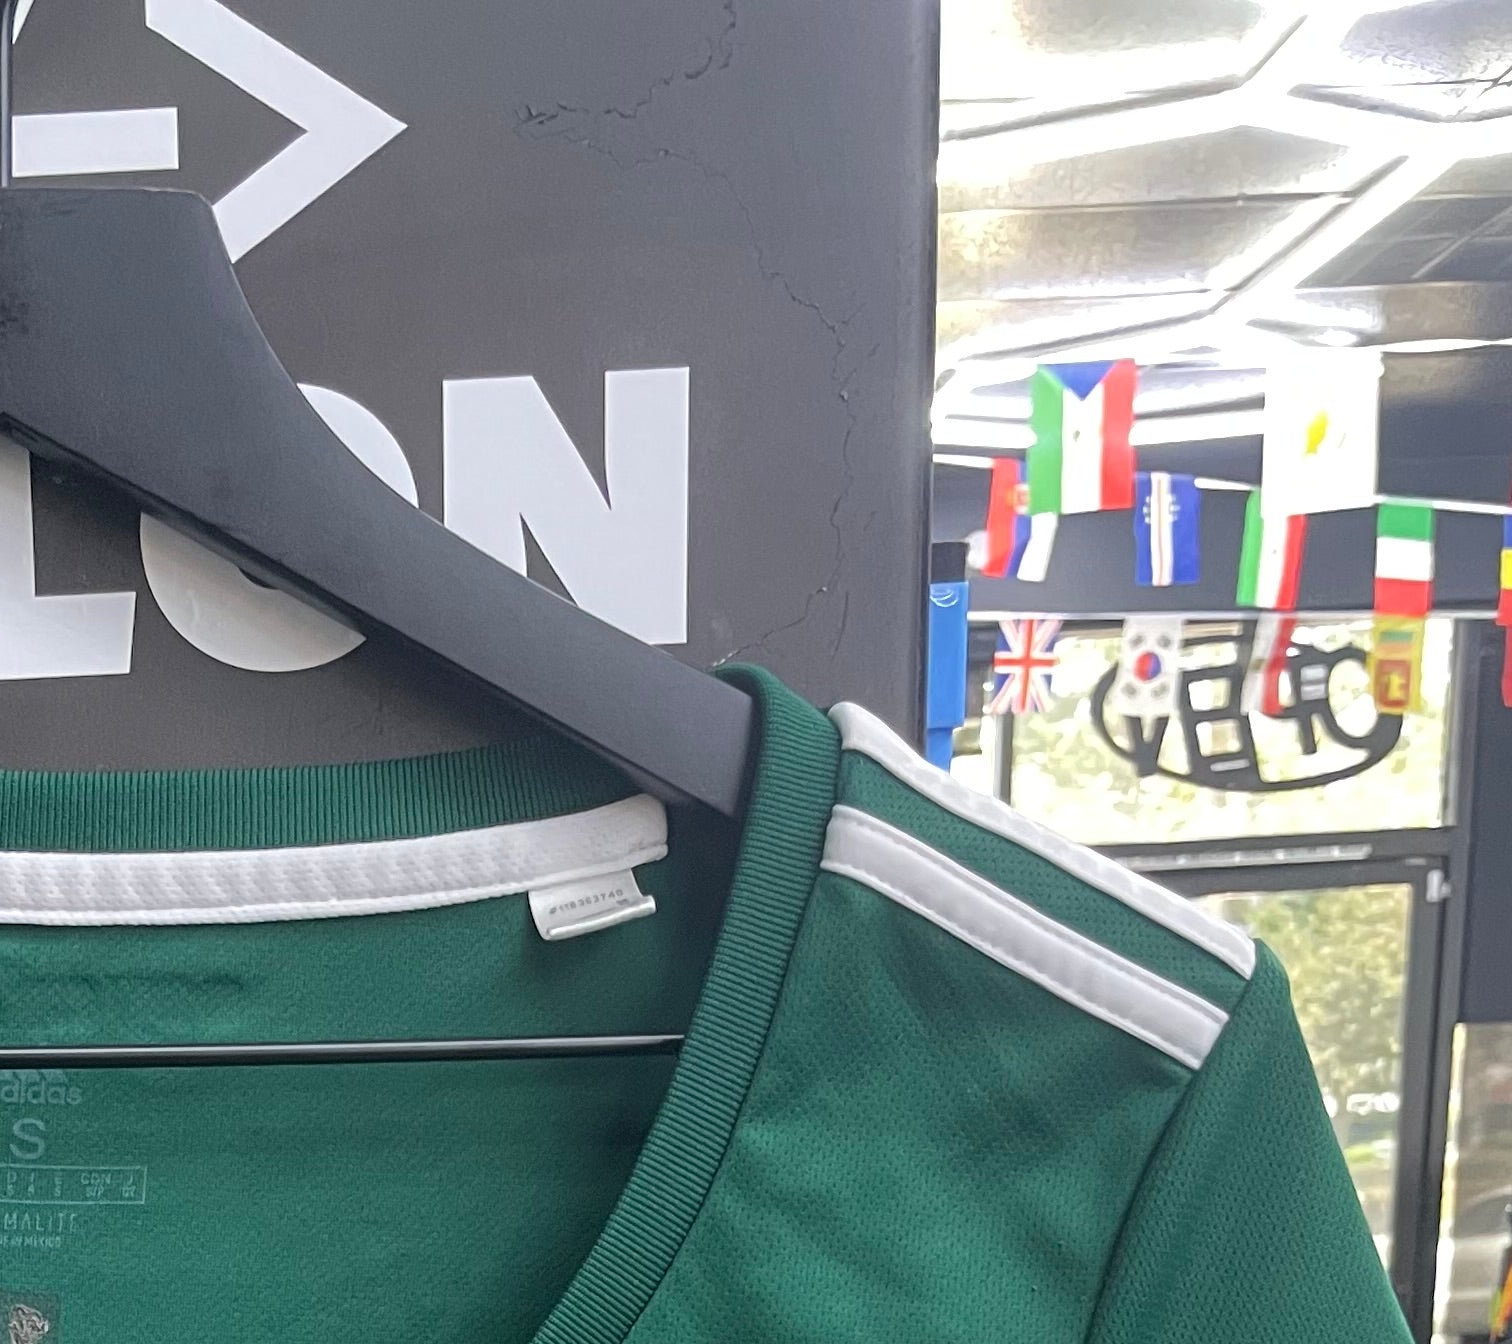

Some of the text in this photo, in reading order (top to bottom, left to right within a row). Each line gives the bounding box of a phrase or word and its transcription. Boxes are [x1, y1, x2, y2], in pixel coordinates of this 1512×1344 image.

[9, 1118, 47, 1160] S
[7, 1171, 17, 1183] D
[80, 1173, 112, 1185] CDN
